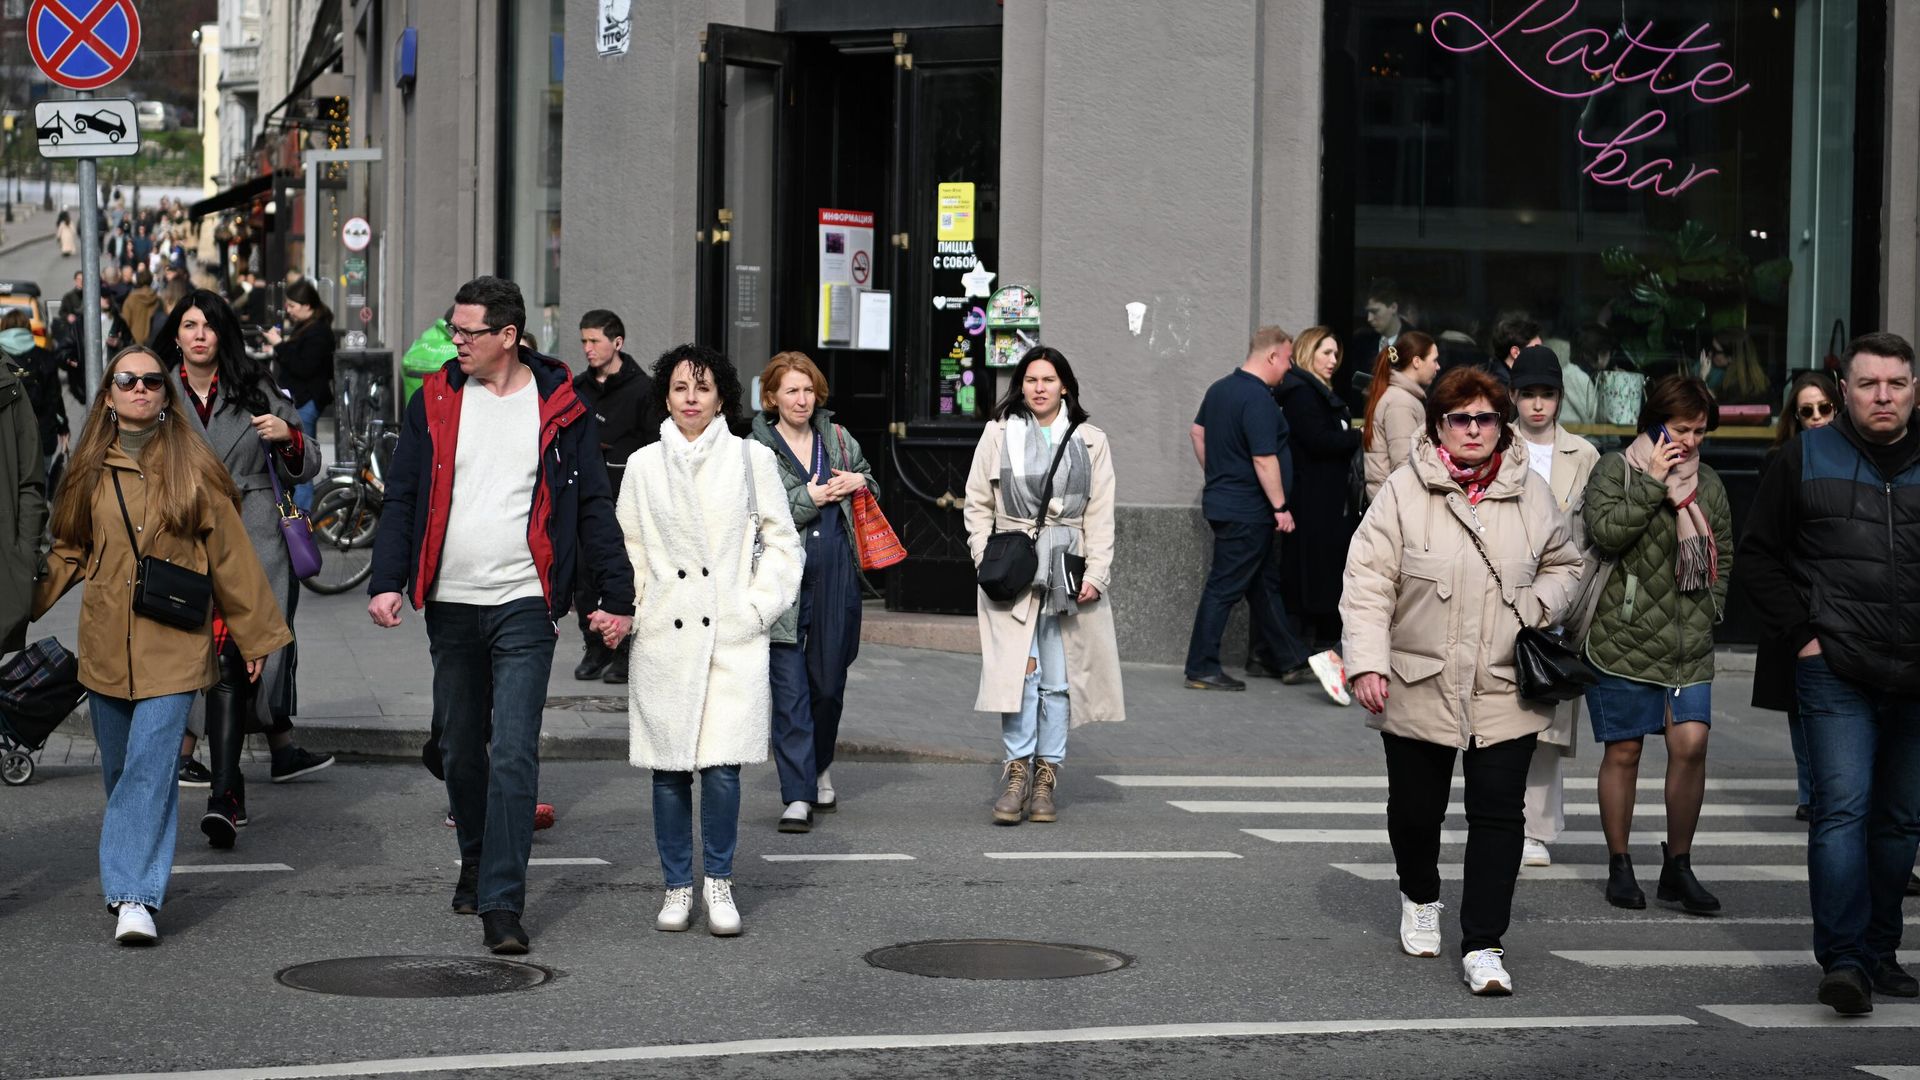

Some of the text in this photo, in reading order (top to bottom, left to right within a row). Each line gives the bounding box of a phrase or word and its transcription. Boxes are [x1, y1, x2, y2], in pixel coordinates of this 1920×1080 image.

[1431, 0, 1750, 103] Latte
[1578, 109, 1720, 197] bar
[823, 211, 873, 224] ИНФОРМАЦИЯ
[938, 241, 974, 254] ПИЦЦА
[933, 254, 978, 269] С СОБОЙ
